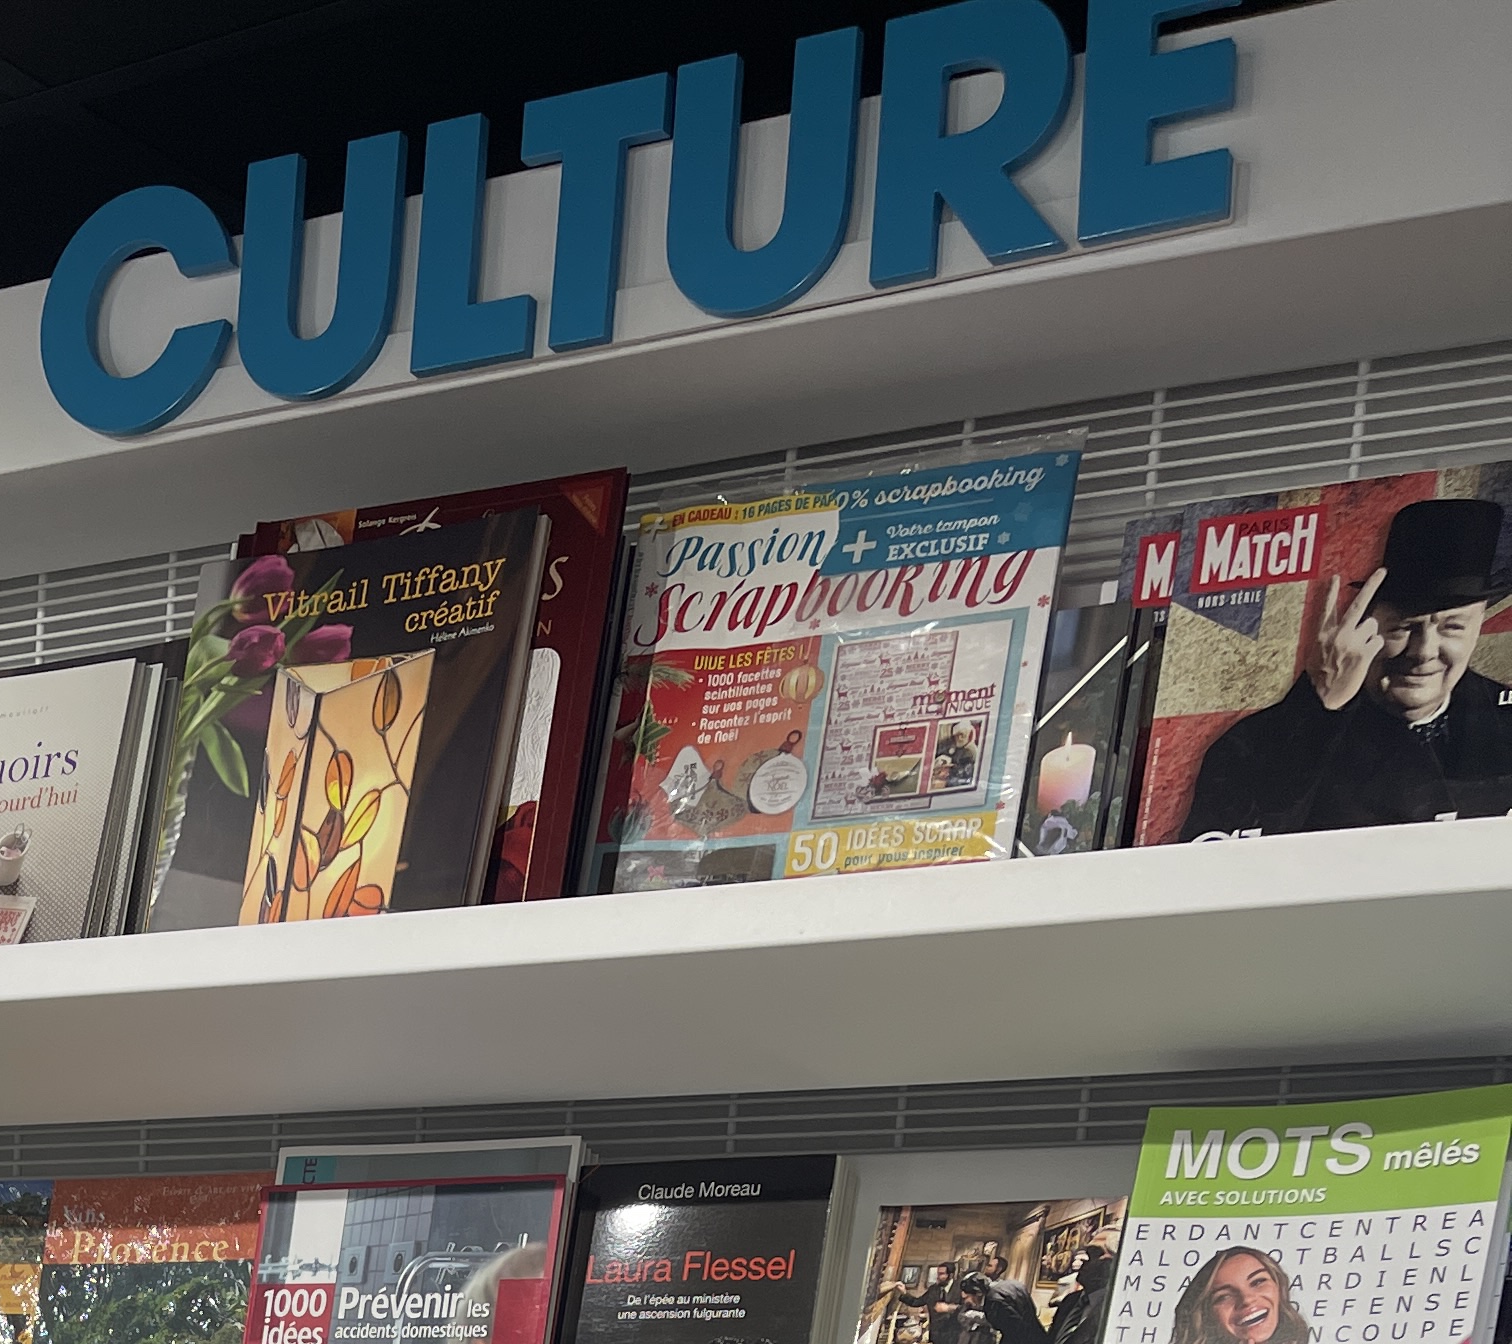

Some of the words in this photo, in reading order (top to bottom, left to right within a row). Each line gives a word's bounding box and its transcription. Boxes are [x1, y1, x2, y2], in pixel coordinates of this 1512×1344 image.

[39, 0, 1242, 437] CULTURE
[874, 465, 1045, 507] scrapbooking
[886, 520, 933, 540] Votre
[935, 512, 1000, 538] tampon
[1239, 518, 1290, 534] PARIS
[657, 527, 838, 579] Passion
[886, 533, 990, 562] EXCLUSIF
[1200, 512, 1318, 585] MATCH
[263, 579, 368, 622] Vitrail
[382, 558, 506, 604] Tiffany
[405, 590, 500, 633] créatif
[699, 713, 752, 731] Racontez
[755, 708, 792, 729] l'esprit
[791, 831, 839, 872] 50
[846, 822, 908, 850] IDÉES
[1164, 1121, 1374, 1182] MOTS
[1382, 1137, 1481, 1172] mêlés
[637, 1182, 694, 1201] Claude
[699, 1179, 761, 1199] Moreau
[1160, 1190, 1211, 1206] AVEC
[1214, 1187, 1327, 1206] SOLUTIONS
[585, 1253, 673, 1286] Laura
[682, 1248, 795, 1282] Flessel
[263, 1286, 327, 1319] 1000
[337, 1283, 465, 1322] Prévenir
[467, 1298, 490, 1318] les
[334, 1321, 398, 1340] accidents
[401, 1320, 489, 1342] domestiques
